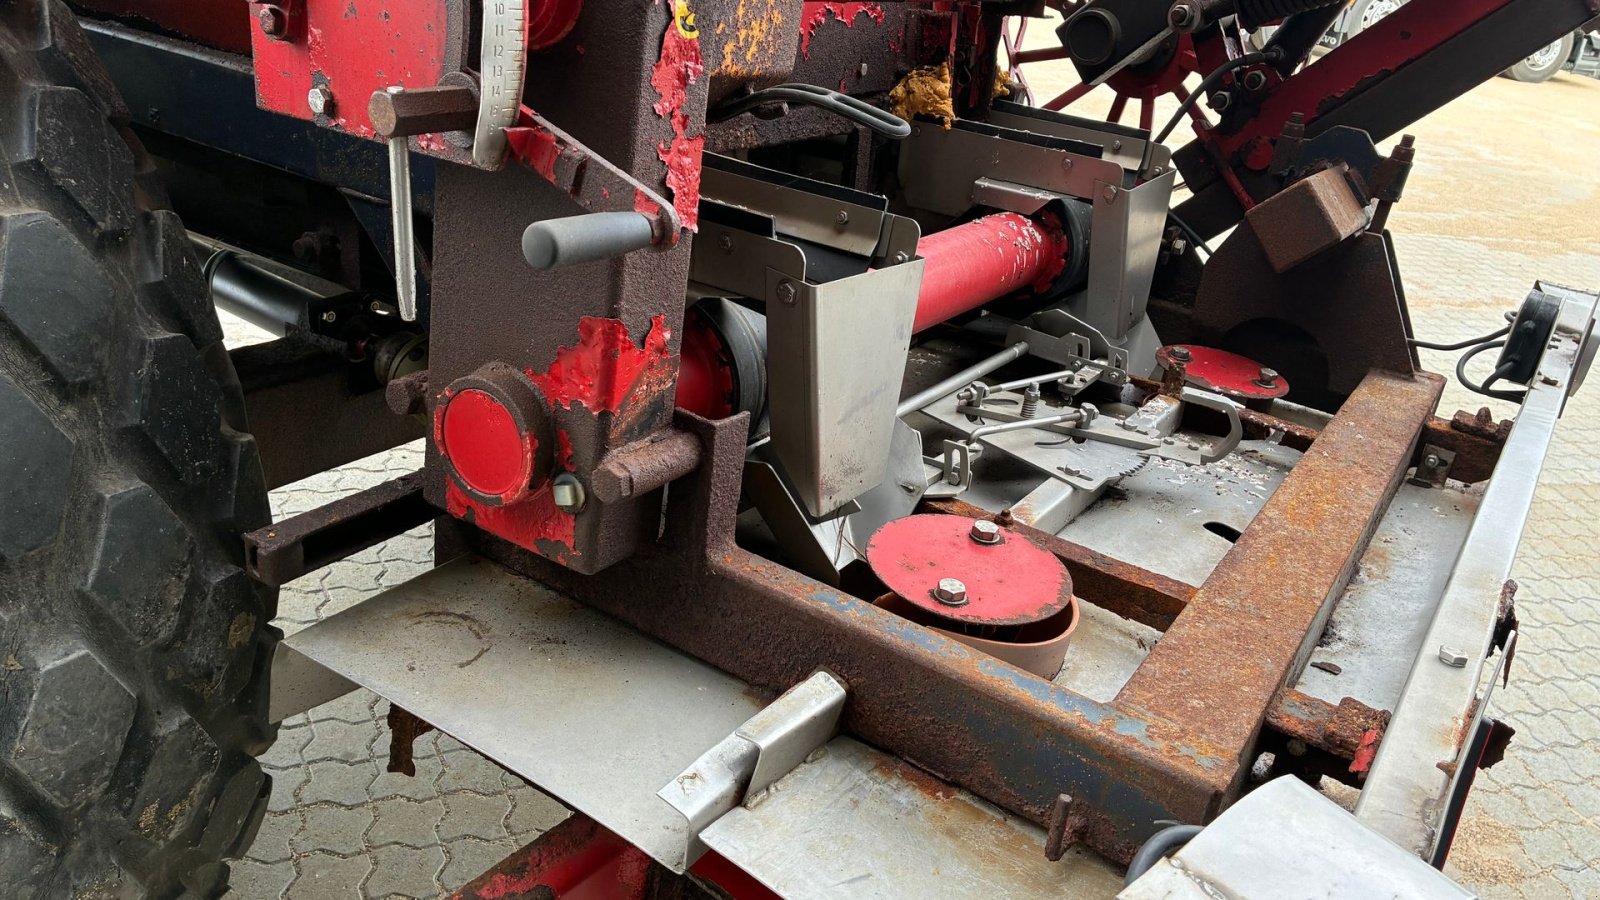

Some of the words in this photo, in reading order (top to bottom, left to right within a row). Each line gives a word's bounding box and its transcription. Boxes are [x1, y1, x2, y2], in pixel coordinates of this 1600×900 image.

[495, 3, 505, 15] 10
[495, 24, 504, 37] 11
[493, 45, 504, 57] 12
[493, 65, 503, 77] 13
[491, 85, 501, 97] 14
